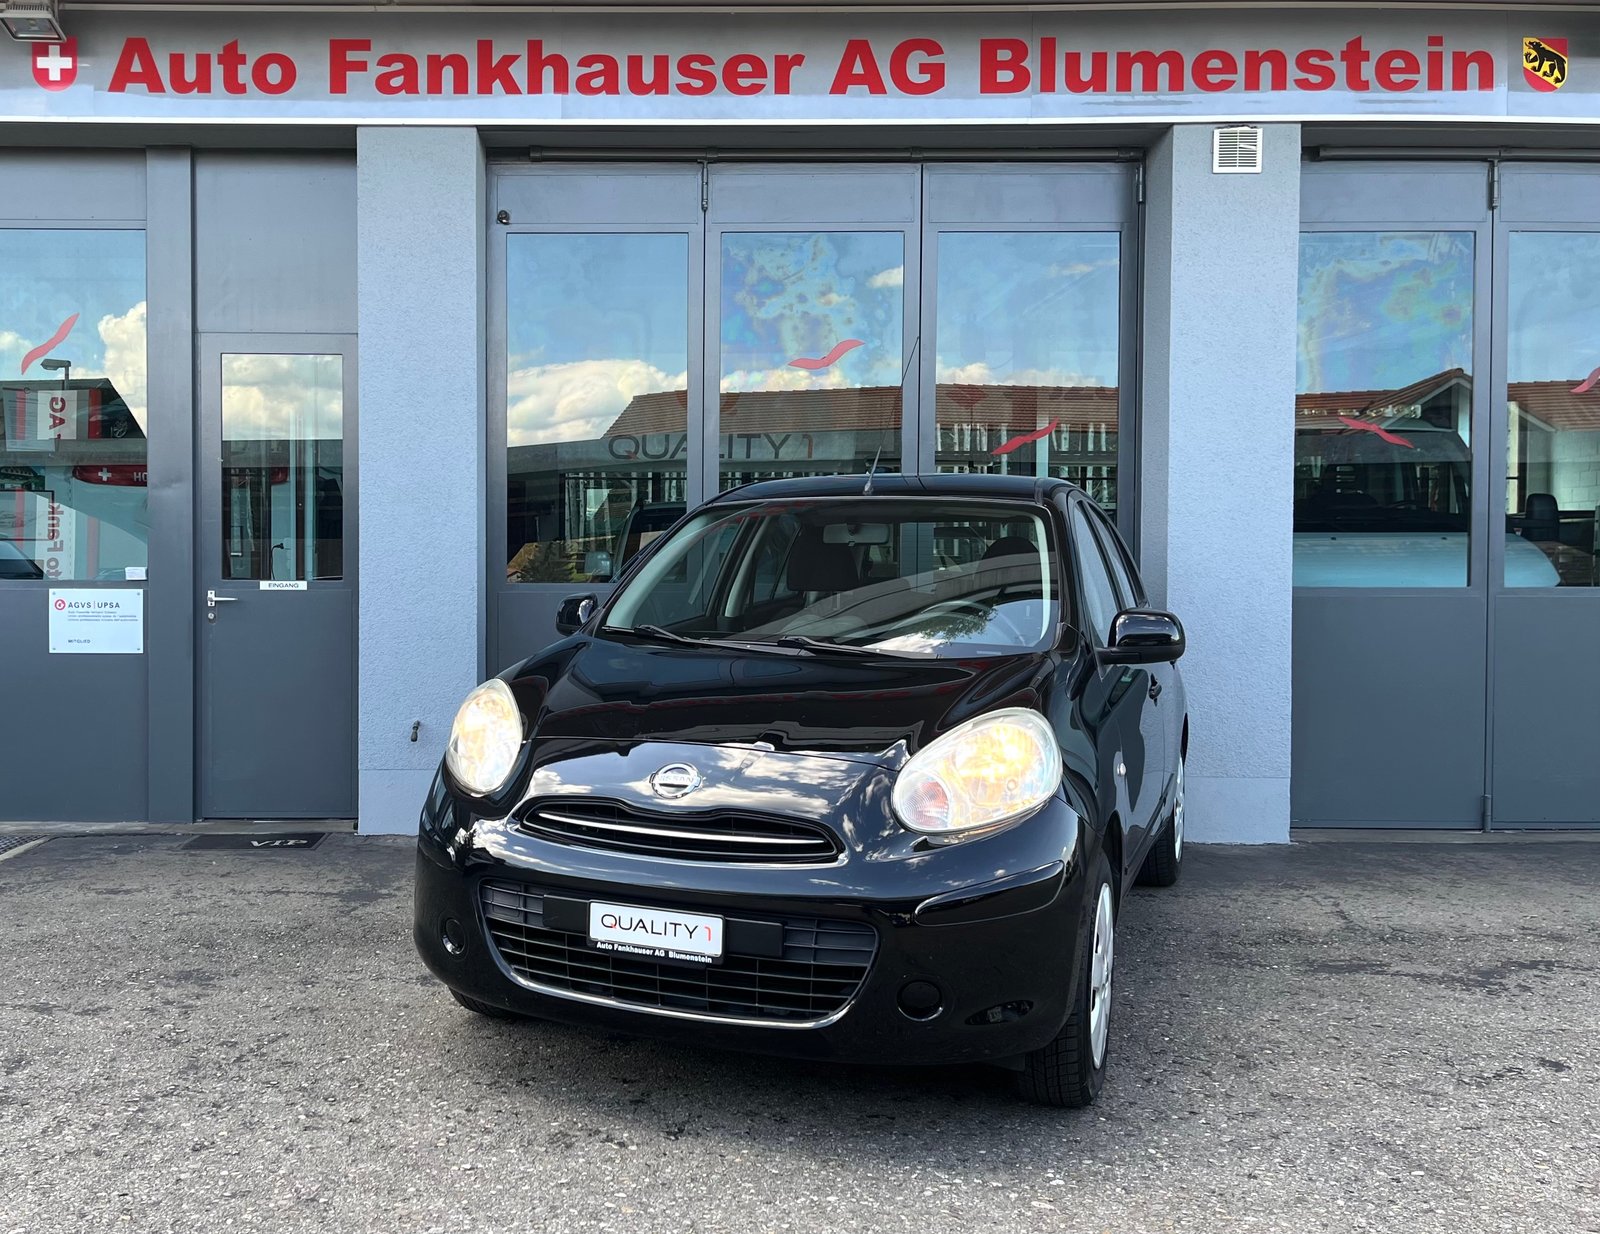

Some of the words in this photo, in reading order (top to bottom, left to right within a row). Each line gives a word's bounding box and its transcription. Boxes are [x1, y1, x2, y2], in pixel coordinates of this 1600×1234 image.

[109, 37, 297, 95] Auto
[328, 38, 806, 96] Fankhauser
[829, 38, 946, 95] AG
[979, 36, 1495, 94] Blumenstein
[608, 433, 792, 461] QUAITY
[802, 433, 814, 459] 1
[68, 601, 92, 609] AGVS
[97, 601, 121, 609] UPSA
[250, 839, 308, 847] VIP
[600, 913, 699, 940] QUALITY
[703, 924, 712, 942] 1
[596, 941, 613, 951] Auto
[613, 943, 654, 956] Fankhauser
[654, 949, 665, 957] AG
[668, 950, 713, 964] Blumenstein
